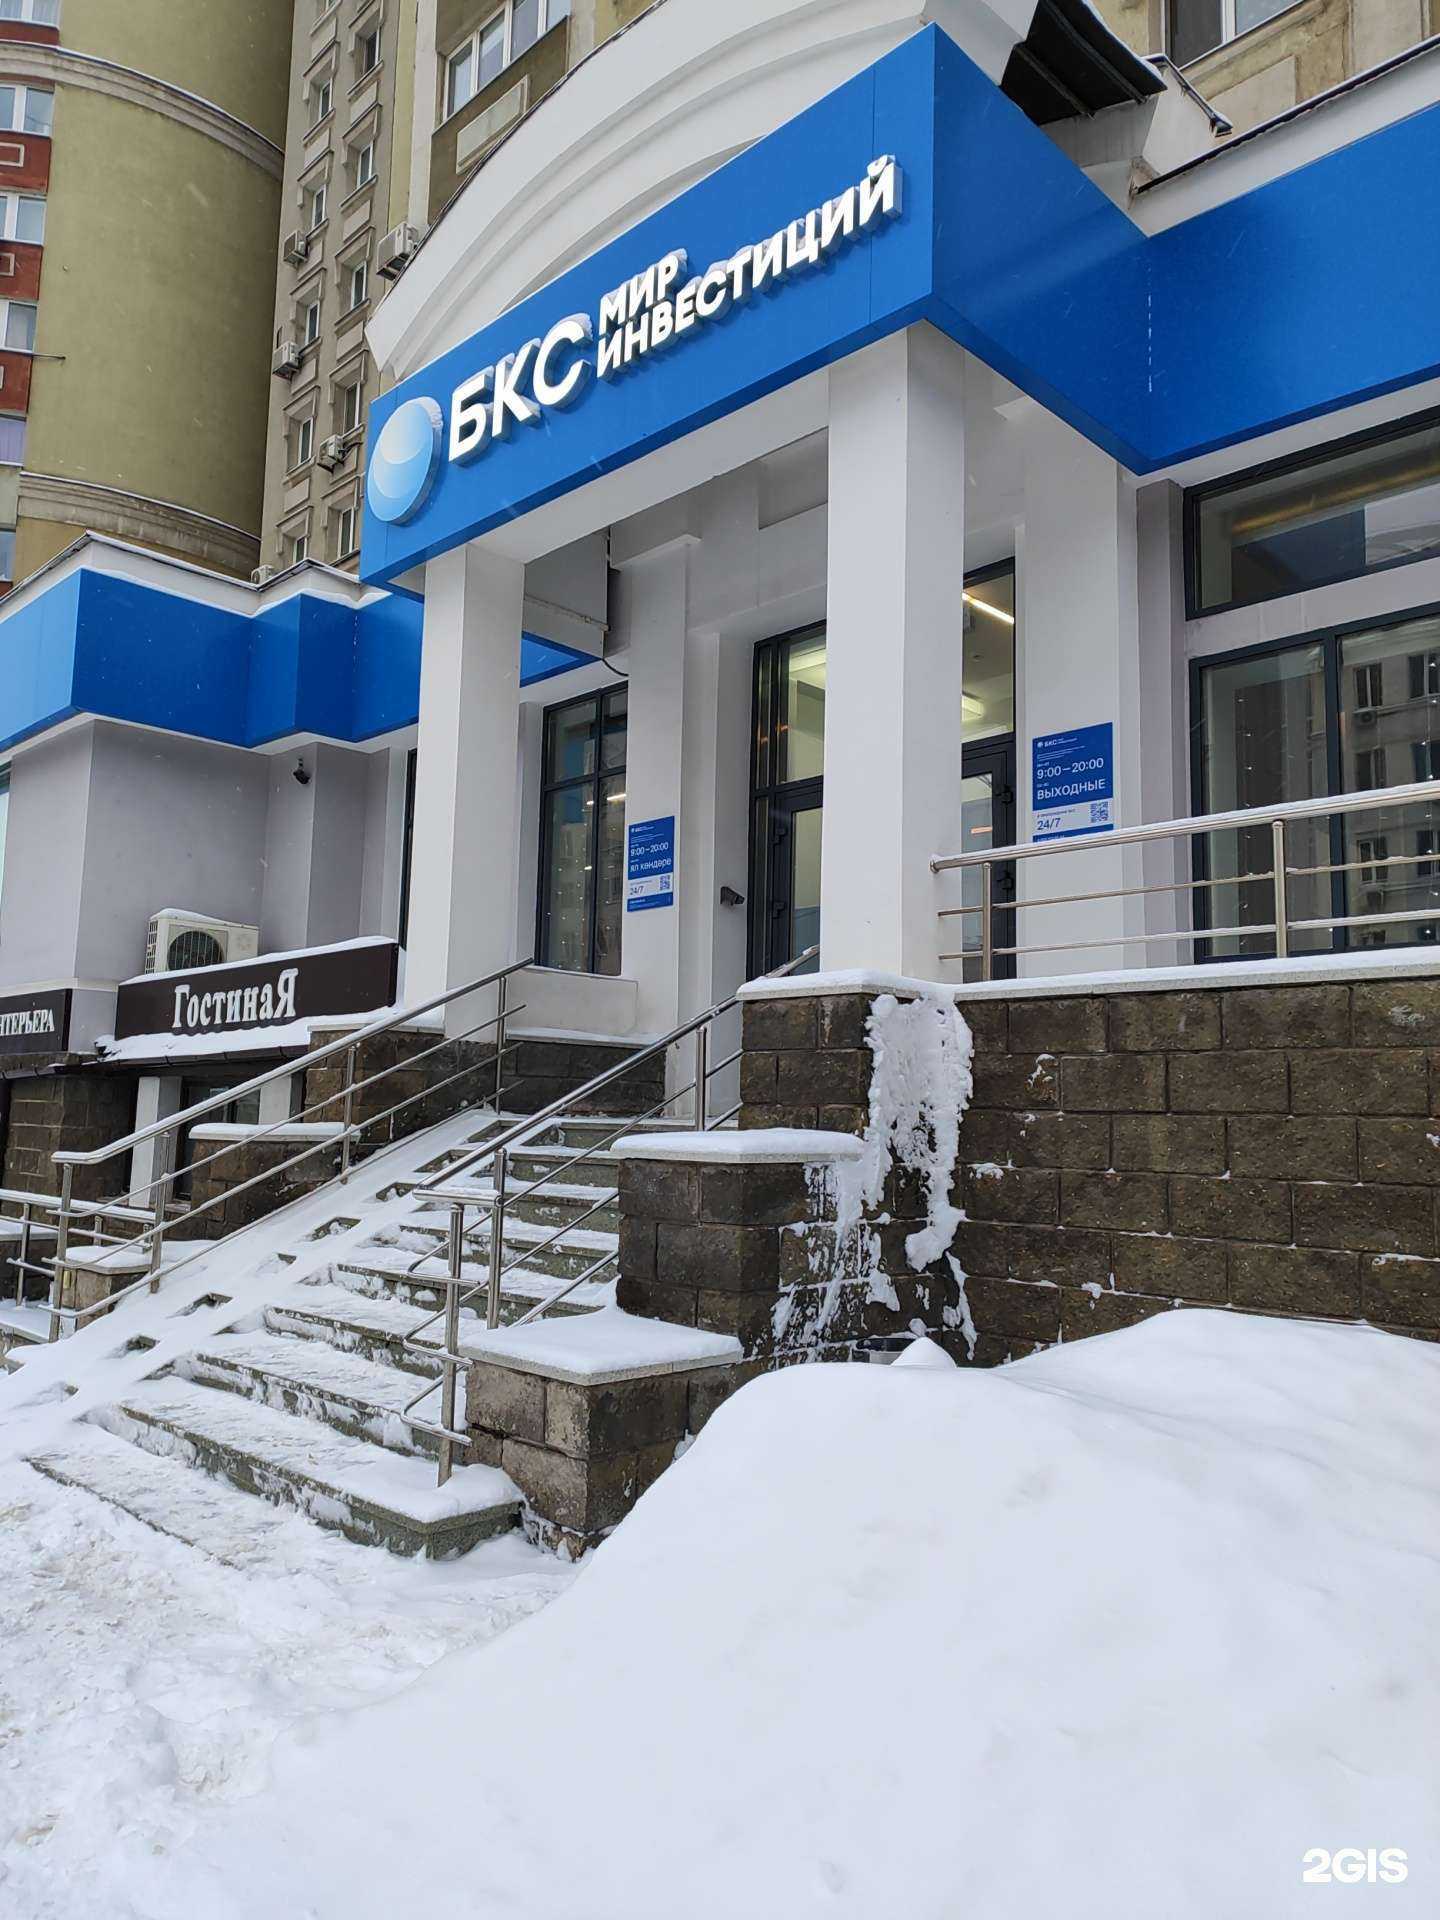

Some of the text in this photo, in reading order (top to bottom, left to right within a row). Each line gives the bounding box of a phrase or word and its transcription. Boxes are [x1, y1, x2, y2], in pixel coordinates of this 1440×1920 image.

[597, 156, 901, 378] ИНВЕСТИЦИЙ
[599, 250, 687, 335] МИР
[449, 316, 592, 464] БКС
[1037, 779, 1106, 800] ВЫХОДНЫЕ
[1037, 818, 1061, 831] 24/7
